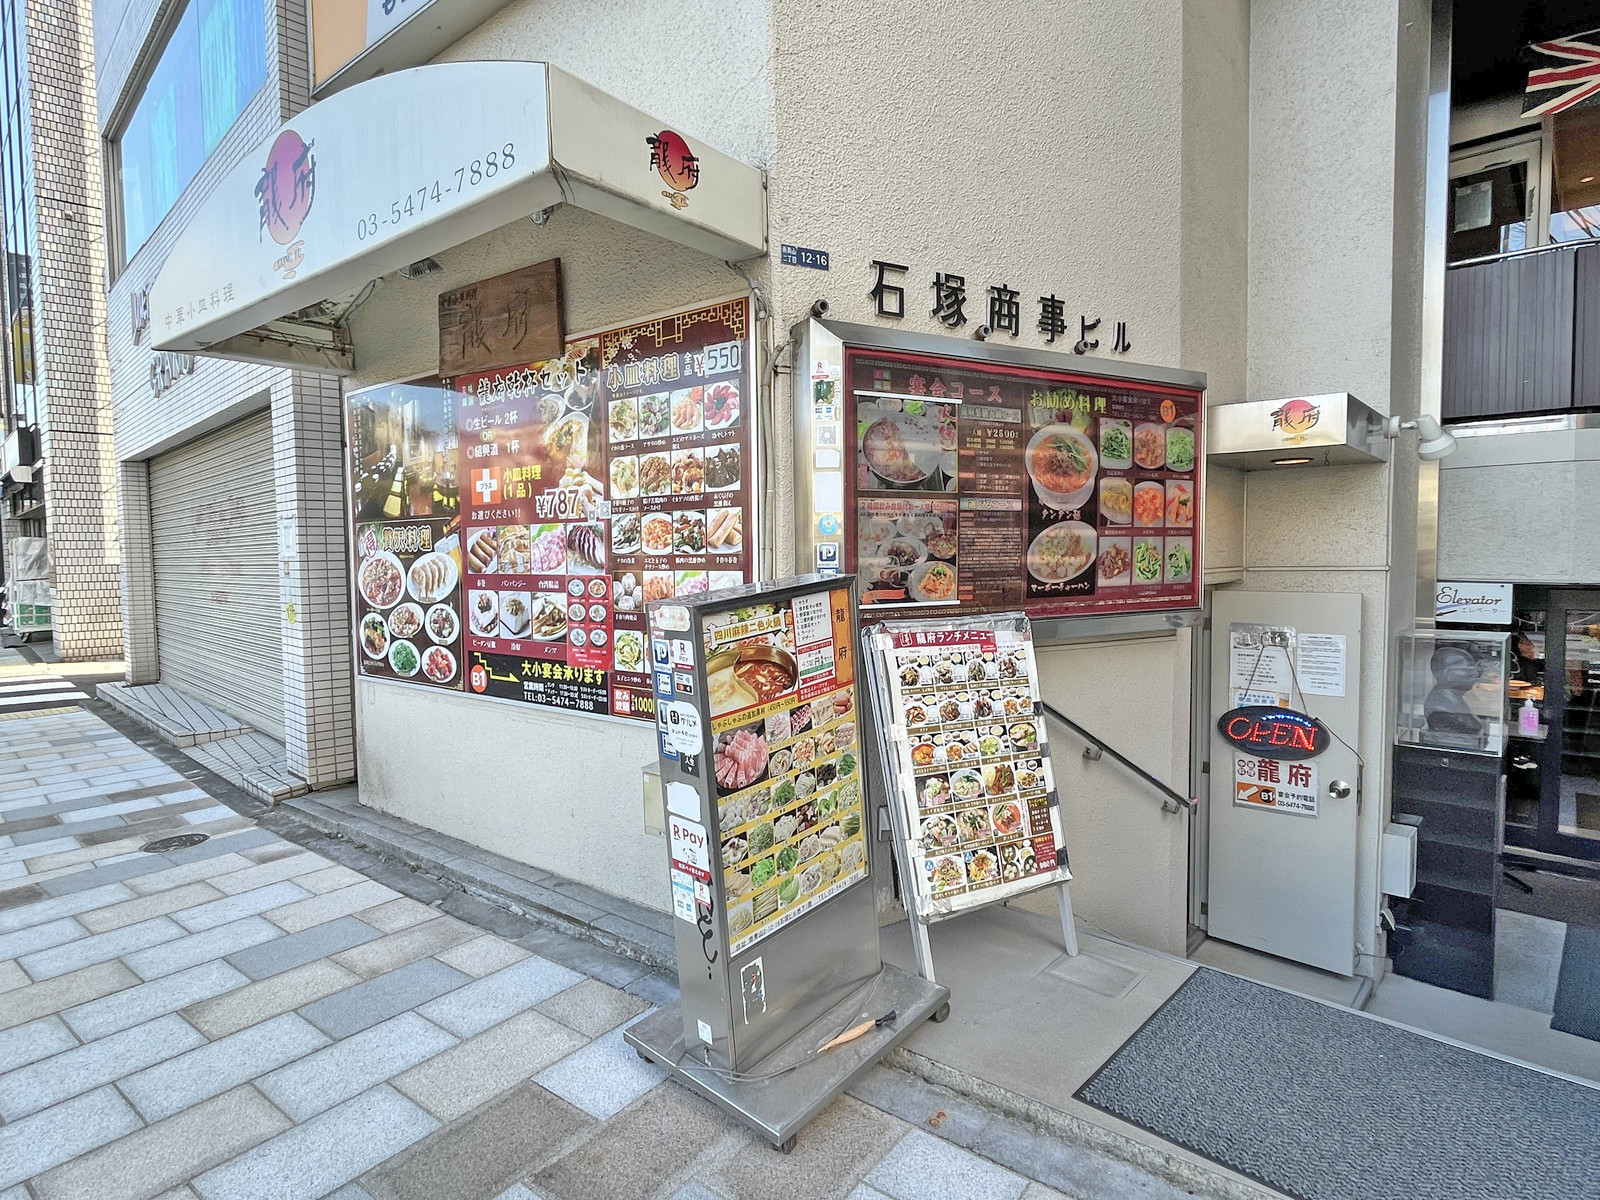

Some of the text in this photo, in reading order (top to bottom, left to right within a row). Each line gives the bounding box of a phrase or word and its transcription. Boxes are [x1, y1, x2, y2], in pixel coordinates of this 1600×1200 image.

[357, 142, 515, 241] 03-5474-7888
[801, 252, 828, 266] 12-16
[869, 259, 1131, 353] 石塚商事ビル
[606, 352, 681, 393] 小皿料理
[683, 352, 693, 377] 全品
[477, 360, 588, 406] 龍府乾杯セット
[908, 374, 1003, 403] 宴会コース
[1030, 389, 1107, 413] お勧め料理
[1162, 405, 1175, 417] B1
[473, 410, 519, 431] 生ビール 2杯
[482, 431, 493, 441] OR
[474, 440, 520, 458] 紹興酒 1杯
[503, 464, 542, 483] 小皿料理
[480, 482, 493, 490] プラス
[535, 489, 580, 519] ¥787
[382, 524, 433, 552] 贅沢料理
[1436, 585, 1503, 606] Elevator
[714, 616, 782, 641] 四川麻辣二色火鍋
[835, 608, 848, 661] 龍府
[915, 632, 995, 645] 龍府ランチメニュー
[472, 669, 487, 687] B1
[521, 660, 605, 686] 大小宴会承ります
[523, 691, 594, 711] TEL:03-5474-7888
[635, 697, 655, 714] 1000
[680, 717, 698, 728] グルメ
[1227, 716, 1318, 751] OPEN
[1257, 758, 1312, 788] 龍府
[1261, 791, 1273, 801] B1
[1277, 800, 1315, 812] 03-5474-7888
[1278, 791, 1315, 803] 宴会予約電話
[673, 824, 704, 849] R Pay
